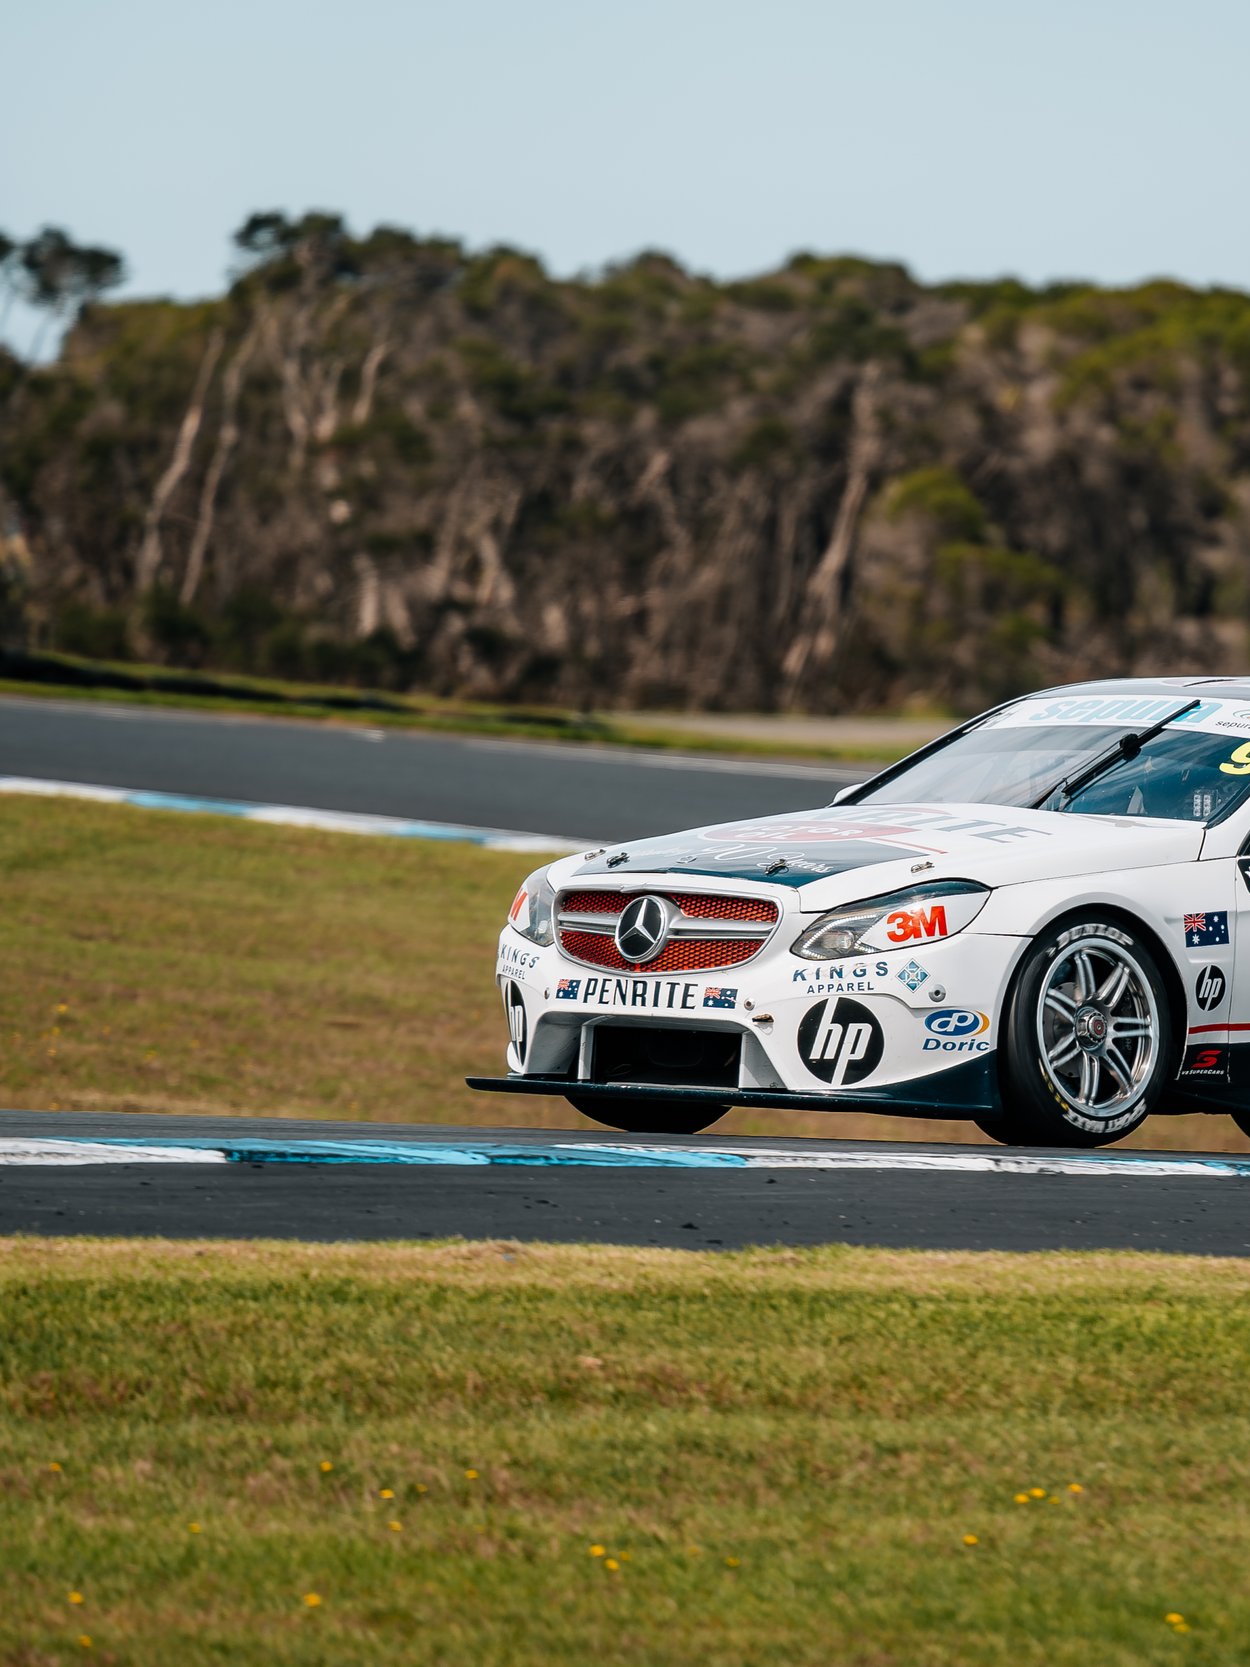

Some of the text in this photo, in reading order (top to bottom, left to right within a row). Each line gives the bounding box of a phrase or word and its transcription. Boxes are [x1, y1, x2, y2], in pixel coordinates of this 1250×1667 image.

[886, 905, 949, 943] 3M
[501, 943, 540, 970] KINGS
[502, 963, 526, 981] APPAREL
[792, 960, 889, 983] KINGS
[582, 977, 699, 1011] PENRITE
[807, 981, 875, 994] APPAREL
[1199, 965, 1223, 1012] hp
[808, 996, 873, 1086] hp
[922, 1038, 990, 1052] Doric
